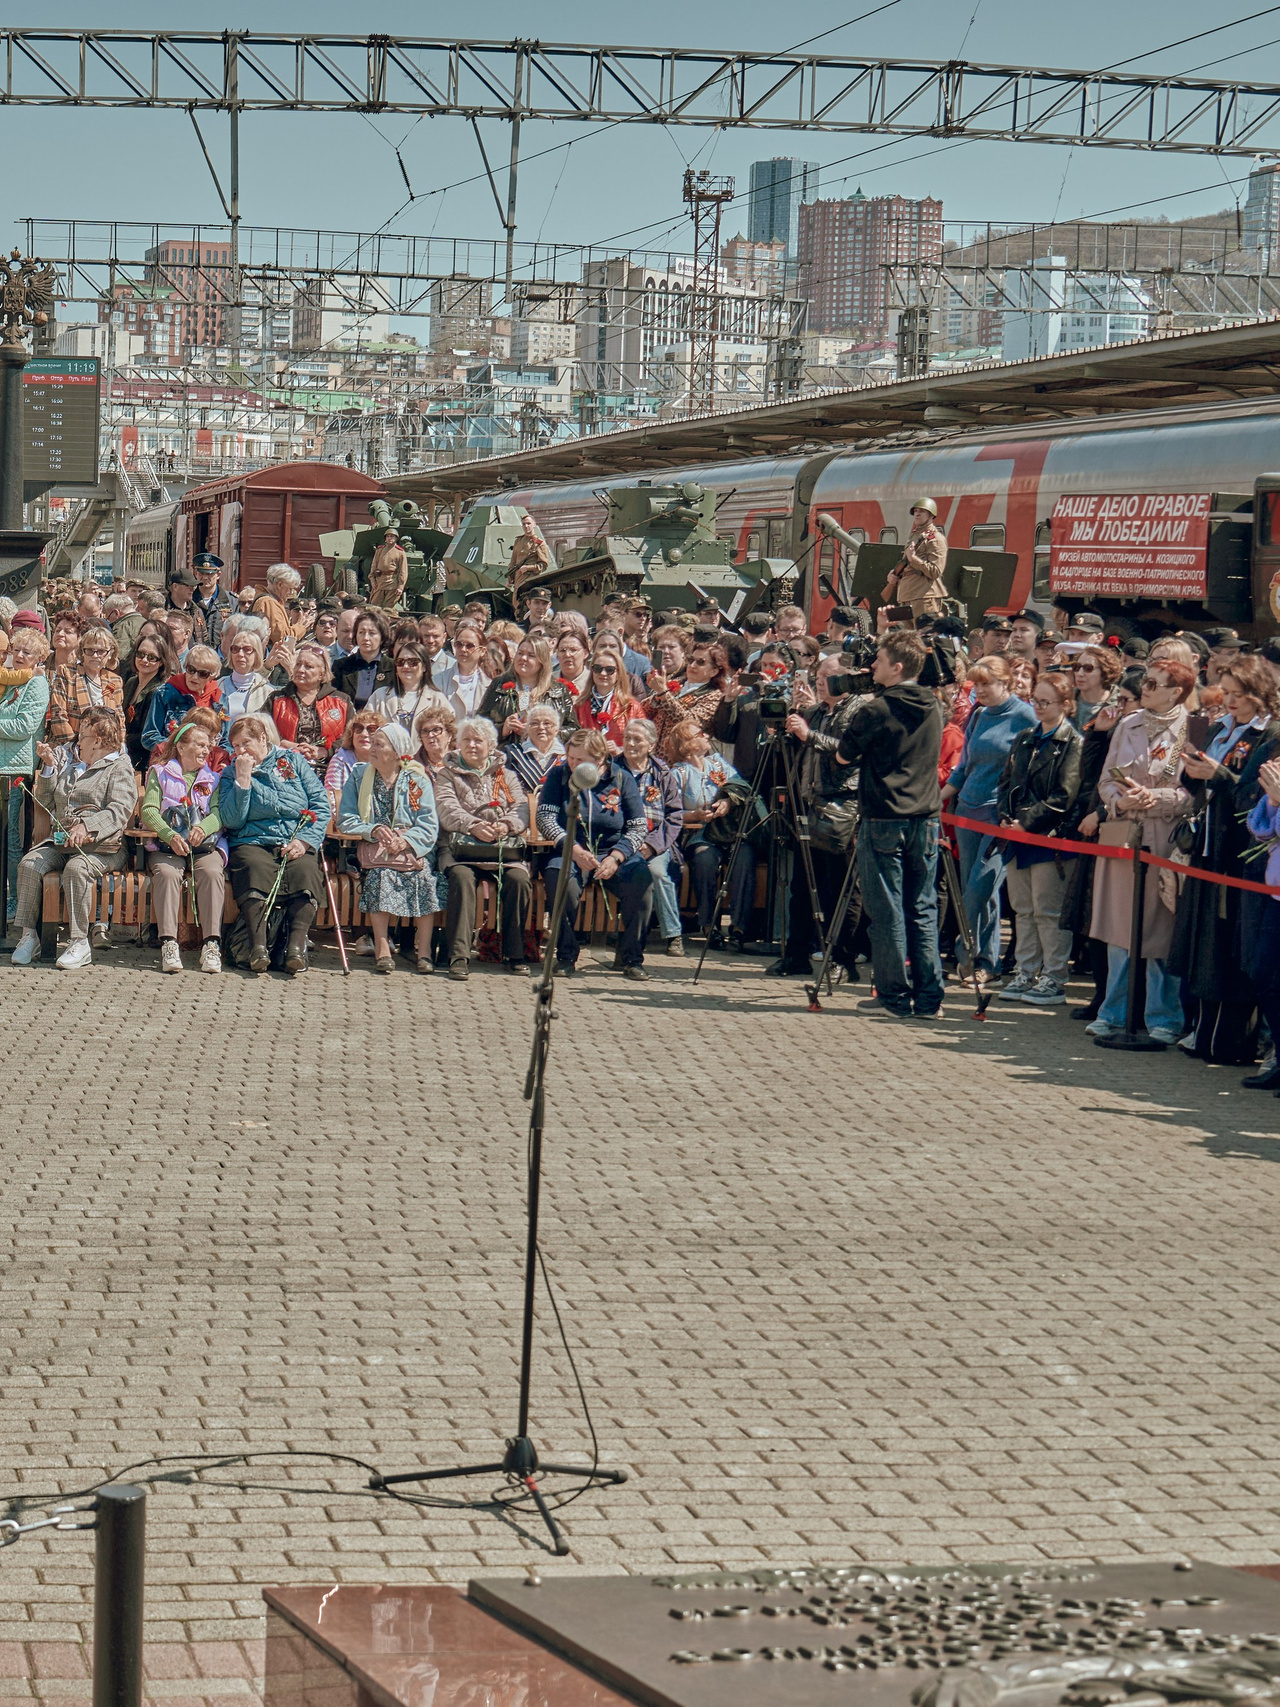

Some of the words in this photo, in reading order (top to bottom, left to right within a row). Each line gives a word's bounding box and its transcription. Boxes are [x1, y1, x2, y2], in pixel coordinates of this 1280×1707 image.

[68, 363, 95, 372] 11:19
[1053, 496, 1099, 518] НАШЕ
[1097, 496, 1139, 520] ДЕЛО
[1140, 494, 1209, 520] ПРАВОЕ,
[1069, 520, 1097, 541] МЫ
[1098, 520, 1190, 545] ПОБЕДИЛИ!
[464, 546, 479, 564] 10
[1058, 550, 1080, 562] МУЗЕЙ
[1081, 552, 1145, 563] АВТОМОТОСТАРИНЫ
[1146, 554, 1153, 563] А.
[1156, 554, 1196, 566] КОЗИЦКОГО
[1059, 566, 1092, 578] САДГОРОДЕ
[1092, 568, 1102, 577] НА
[1102, 568, 1117, 578] БАЗЕ
[1117, 568, 1205, 580] ВОЕННО-ПАТРИОТИЧЕСКОГО
[1111, 583, 1127, 592] ВЕКА
[1129, 584, 1133, 593] В
[1134, 584, 1181, 595] ПРИМОРСКОМ
